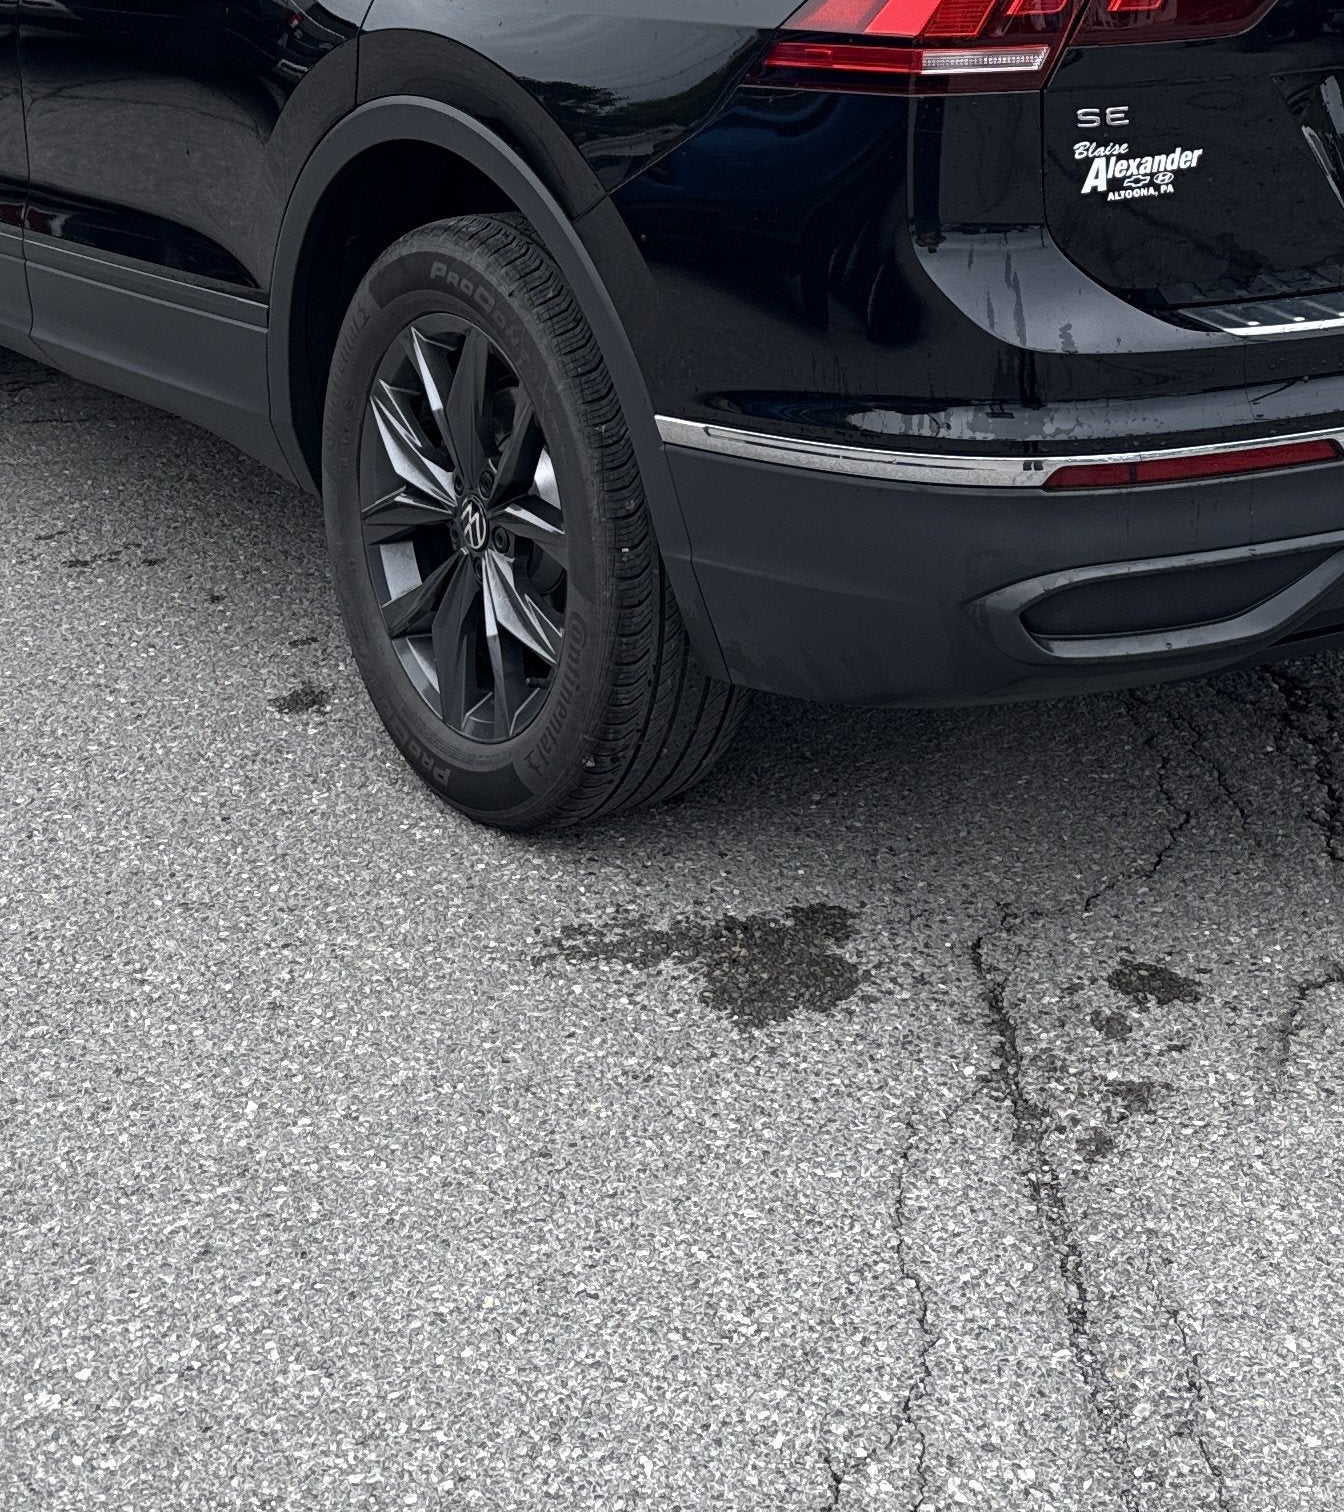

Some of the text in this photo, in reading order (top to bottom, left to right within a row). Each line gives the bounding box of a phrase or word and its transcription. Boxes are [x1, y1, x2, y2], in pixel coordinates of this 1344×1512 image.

[1076, 105, 1130, 128] SE
[1073, 141, 1129, 160] Blaise
[1081, 147, 1204, 194] Alexander
[1107, 184, 1174, 201] ALTOONA, PA
